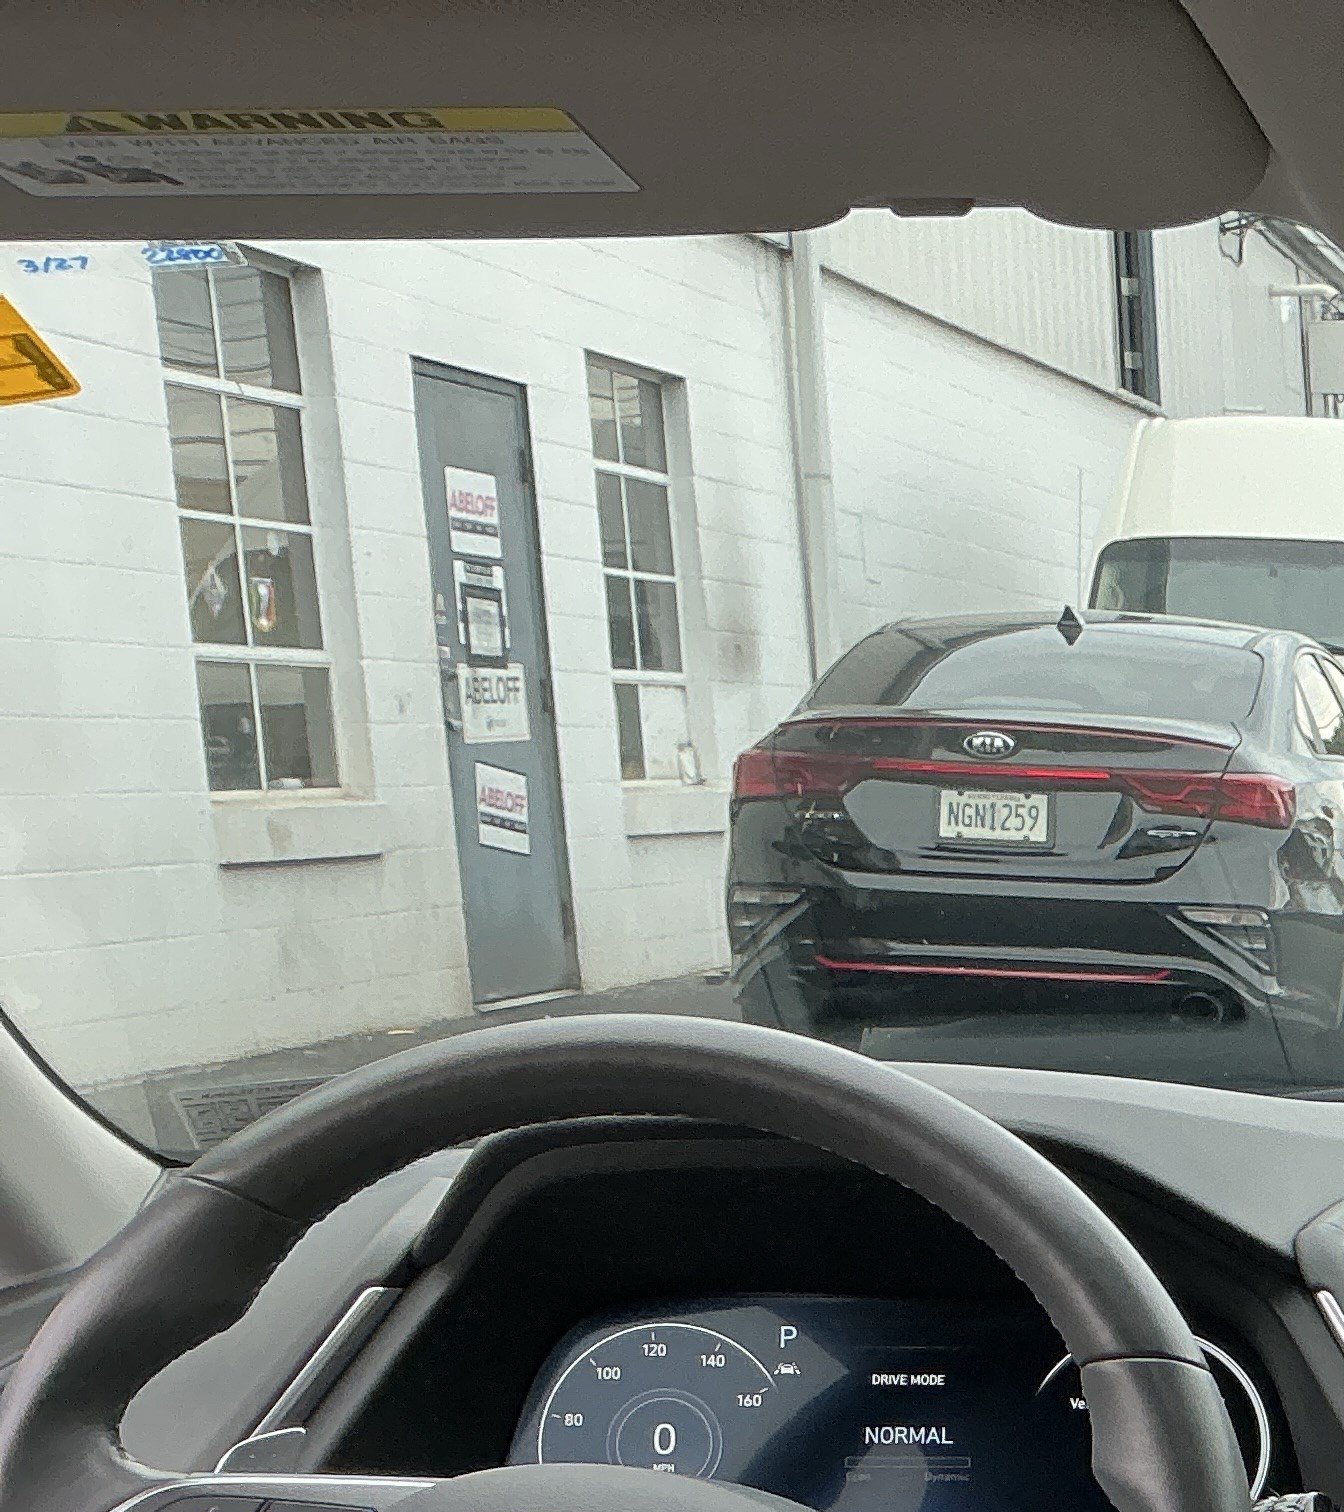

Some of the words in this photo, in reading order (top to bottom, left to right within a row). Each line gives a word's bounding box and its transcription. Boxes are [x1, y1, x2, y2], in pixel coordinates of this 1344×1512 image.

[122, 112, 446, 131] WARNING
[17, 255, 89, 275] 3/27
[465, 676, 521, 705] ABELOFF
[946, 801, 1040, 832] NGN1259
[780, 1325, 798, 1349] P
[642, 1343, 667, 1357] 120
[700, 1354, 726, 1368] 140
[596, 1367, 621, 1381] 100
[871, 1373, 908, 1386] DRIVE
[910, 1374, 946, 1386] MODE
[737, 1394, 763, 1407] 160
[1069, 1397, 1090, 1410] Ve
[564, 1413, 584, 1427] 80
[653, 1423, 677, 1455] 0
[864, 1426, 954, 1445] NORMAL
[652, 1463, 675, 1473] MPH
